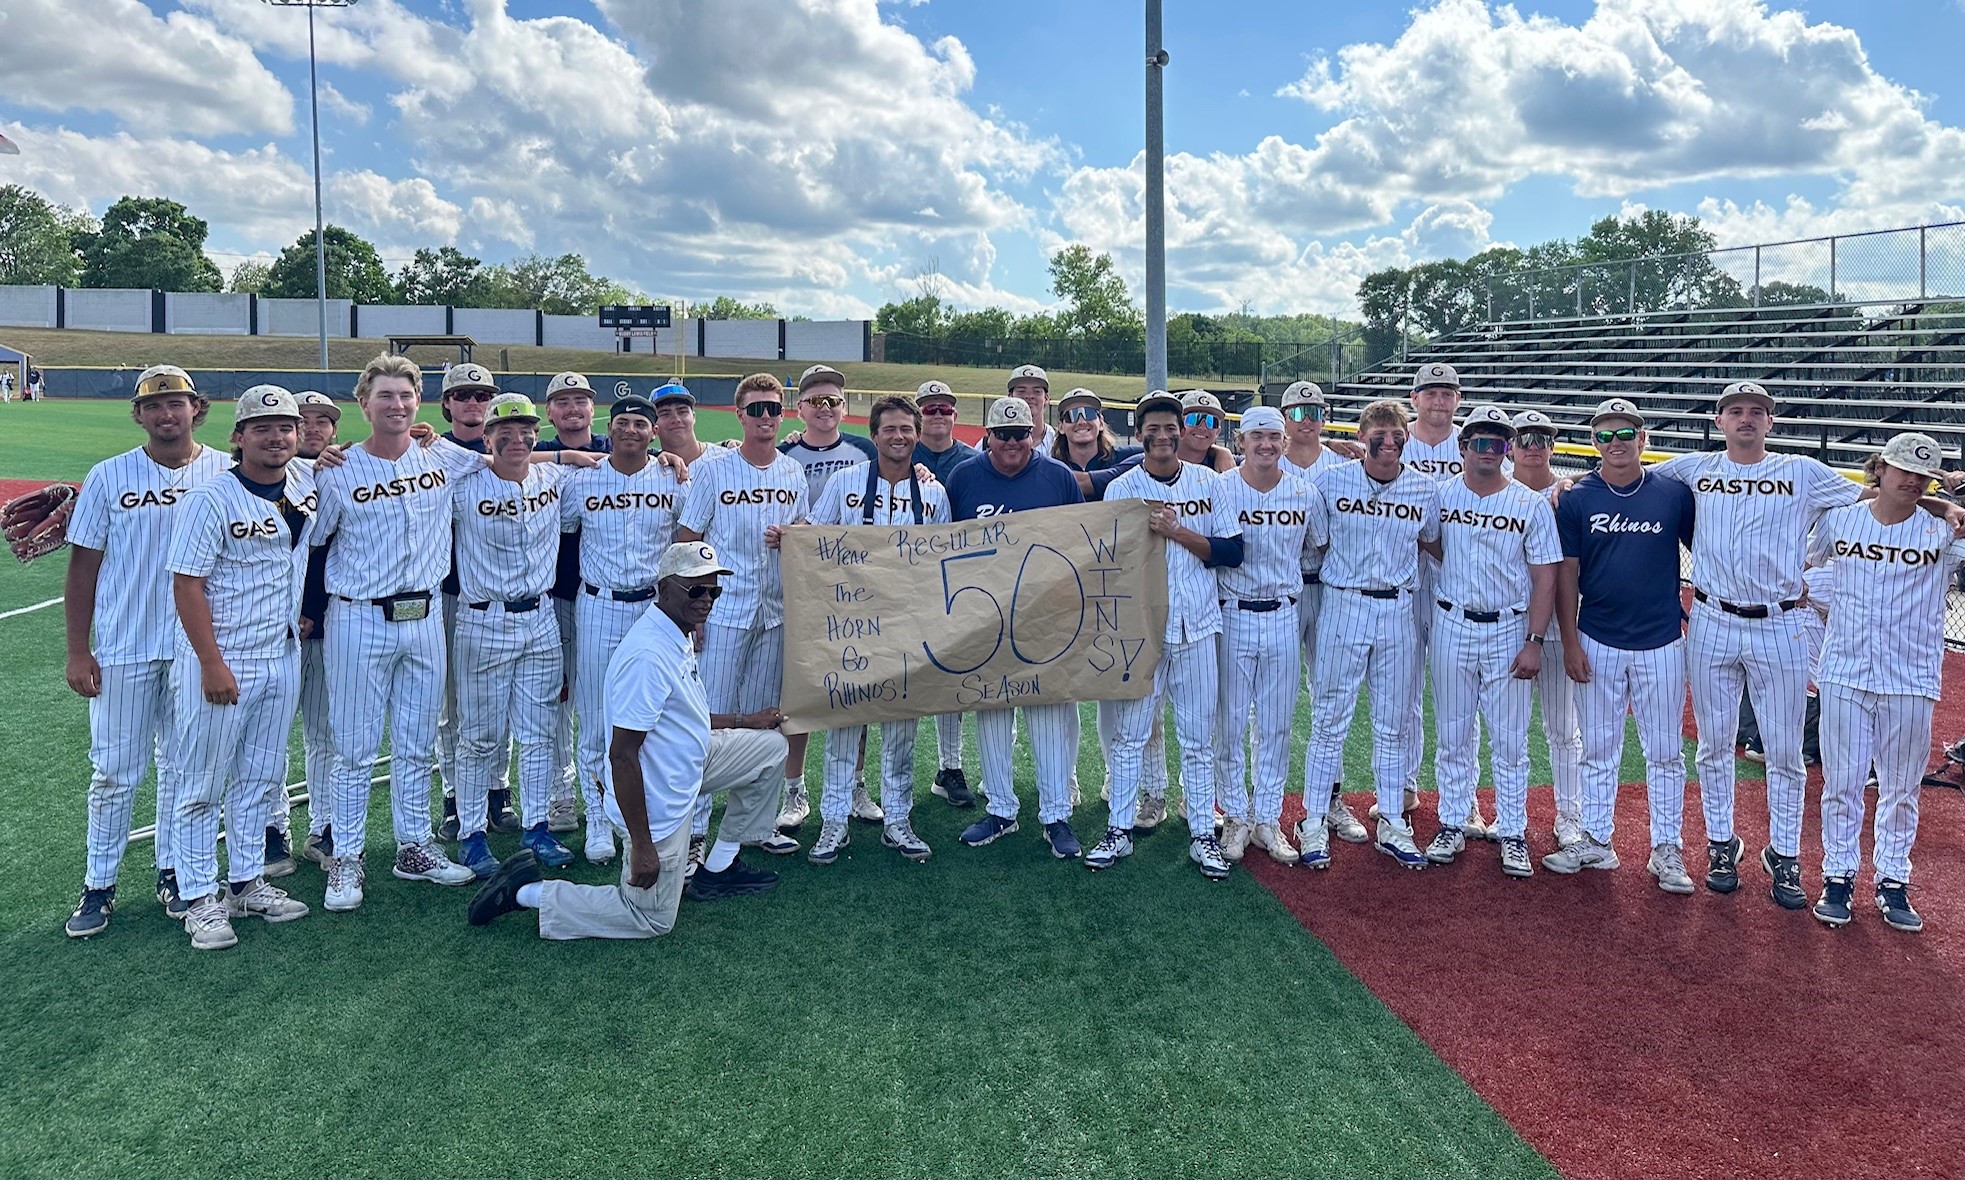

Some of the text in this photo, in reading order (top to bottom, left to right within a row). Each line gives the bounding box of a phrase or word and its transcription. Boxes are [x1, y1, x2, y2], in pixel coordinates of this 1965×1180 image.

[467, 369, 482, 382] G
[1431, 366, 1444, 377] G
[563, 374, 578, 386] G
[929, 384, 941, 394] G
[1300, 387, 1313, 399] G
[1738, 384, 1754, 395] G
[261, 392, 280, 407] G
[1197, 395, 1211, 406] G
[1610, 401, 1625, 413] G
[1004, 404, 1018, 419] G
[1487, 409, 1501, 421] G
[1527, 413, 1541, 422] G
[1914, 446, 1931, 461] G
[352, 468, 447, 504] GASTON
[1696, 476, 1795, 497] GASTON
[477, 484, 560, 517] GASTON
[585, 492, 674, 512] GASTON
[719, 487, 799, 507] GASTON
[1335, 496, 1423, 523] GASTON
[1238, 509, 1307, 527] ASTON
[1589, 512, 1664, 535] Rhinos
[699, 545, 714, 561] G
[1834, 539, 1941, 566] GASTON
[827, 581, 874, 603] The
[922, 543, 1086, 675] 50
[826, 614, 882, 642] HORN
